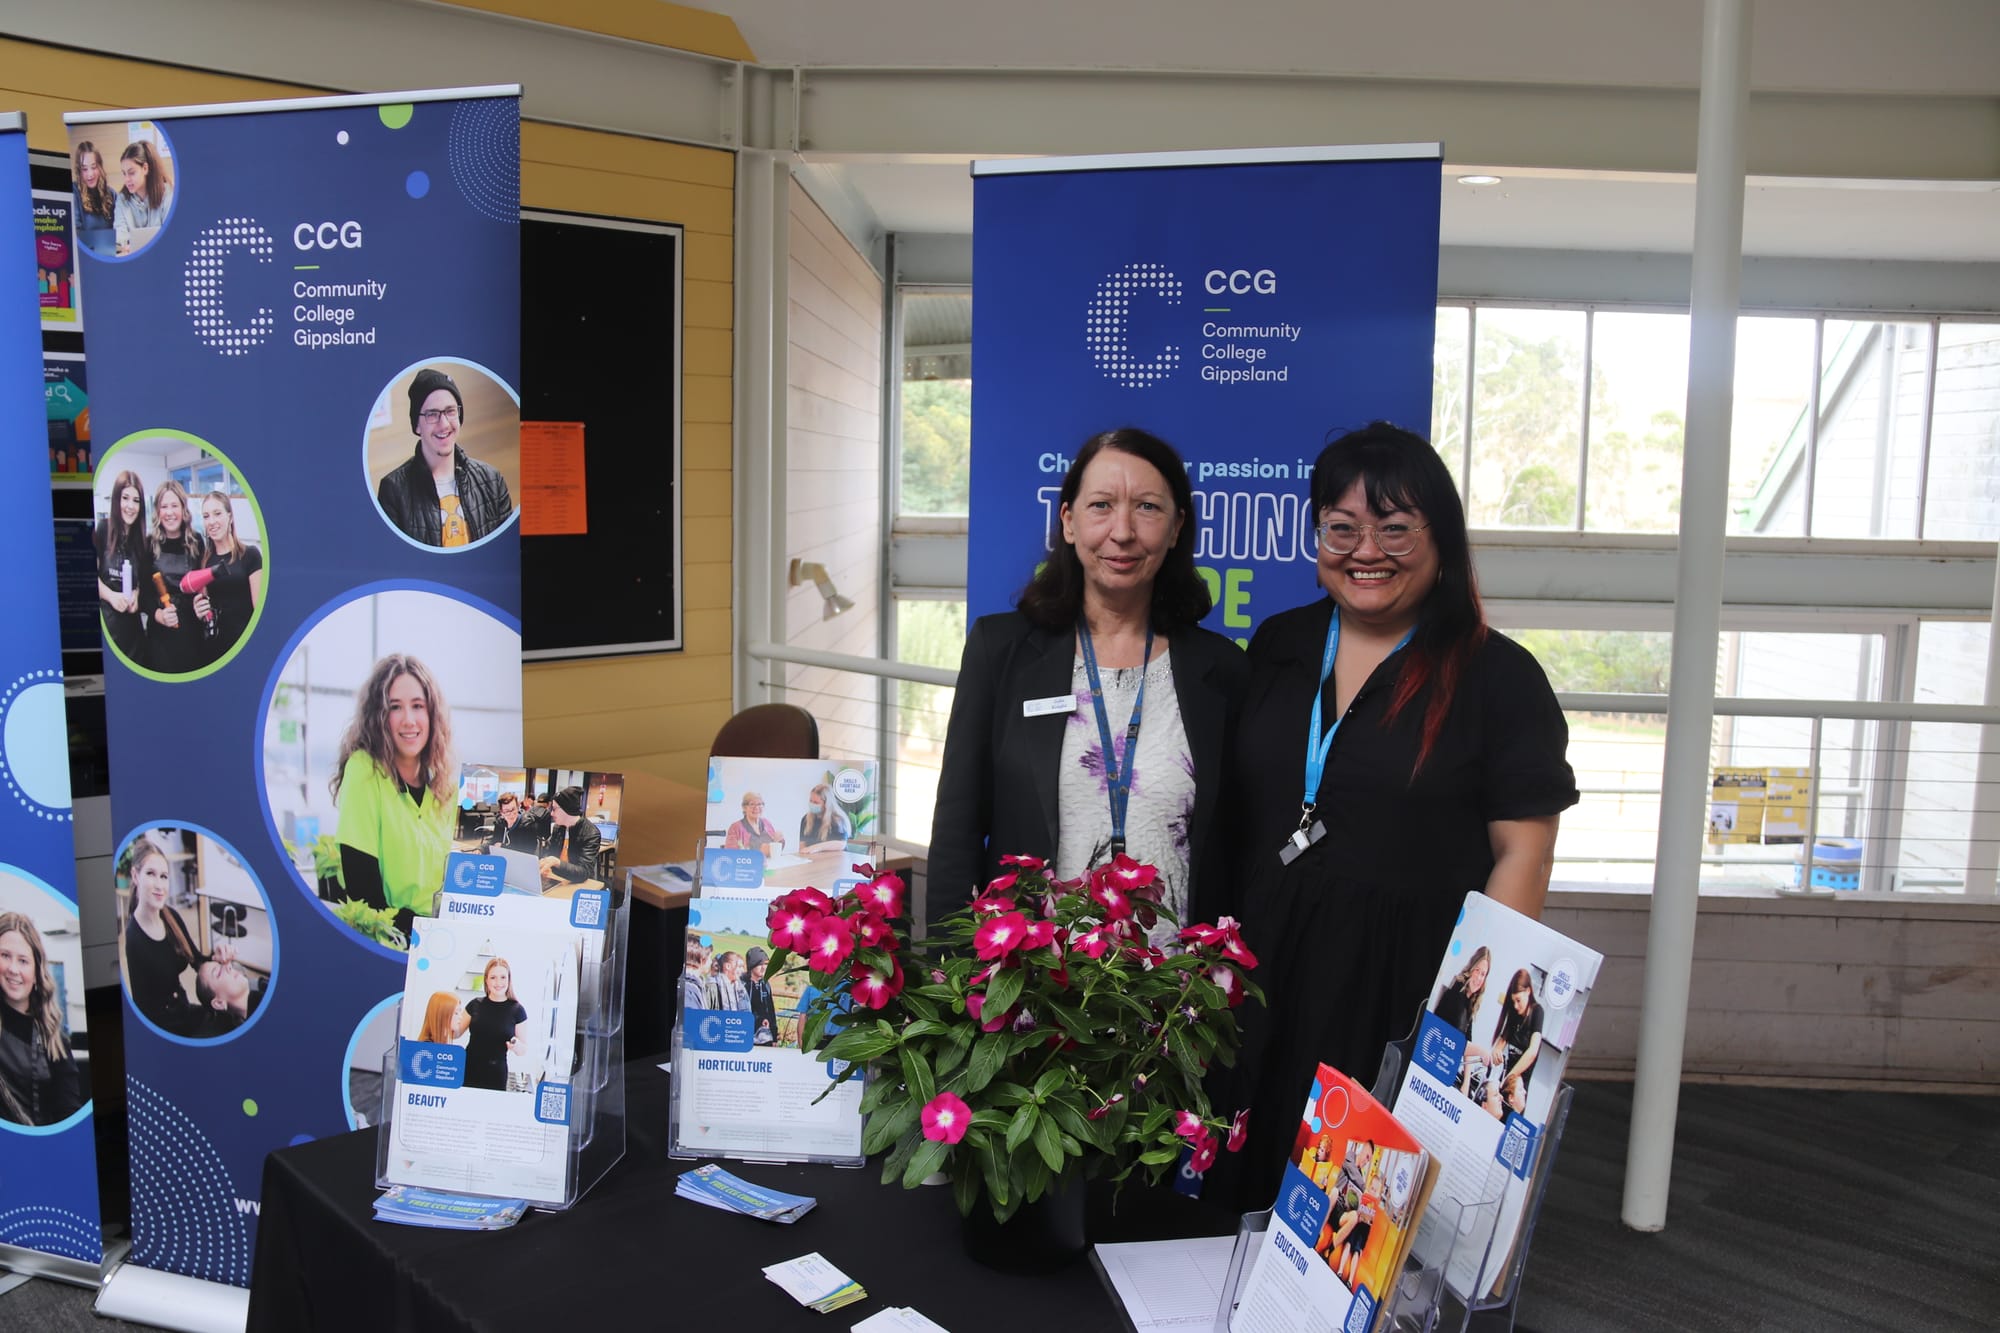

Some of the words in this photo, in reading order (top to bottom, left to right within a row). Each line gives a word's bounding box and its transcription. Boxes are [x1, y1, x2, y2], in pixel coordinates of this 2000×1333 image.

[52, 208, 66, 218] up
[293, 221, 363, 250] CCG
[293, 279, 387, 300] Community
[1204, 269, 1276, 294] CCG
[293, 305, 356, 325] College
[293, 327, 376, 350] Gippsland
[1202, 322, 1301, 342] Community
[1201, 344, 1267, 363] College
[1201, 366, 1288, 384] Gippsland
[1198, 457, 1289, 482] passion
[448, 901, 495, 917] BUSINESS
[698, 1058, 773, 1074] HORTICULTURE
[407, 1092, 447, 1108] BEAUTY
[1409, 1074, 1463, 1125] HAIRDRESSING
[1274, 1230, 1309, 1276] EDUCATION
